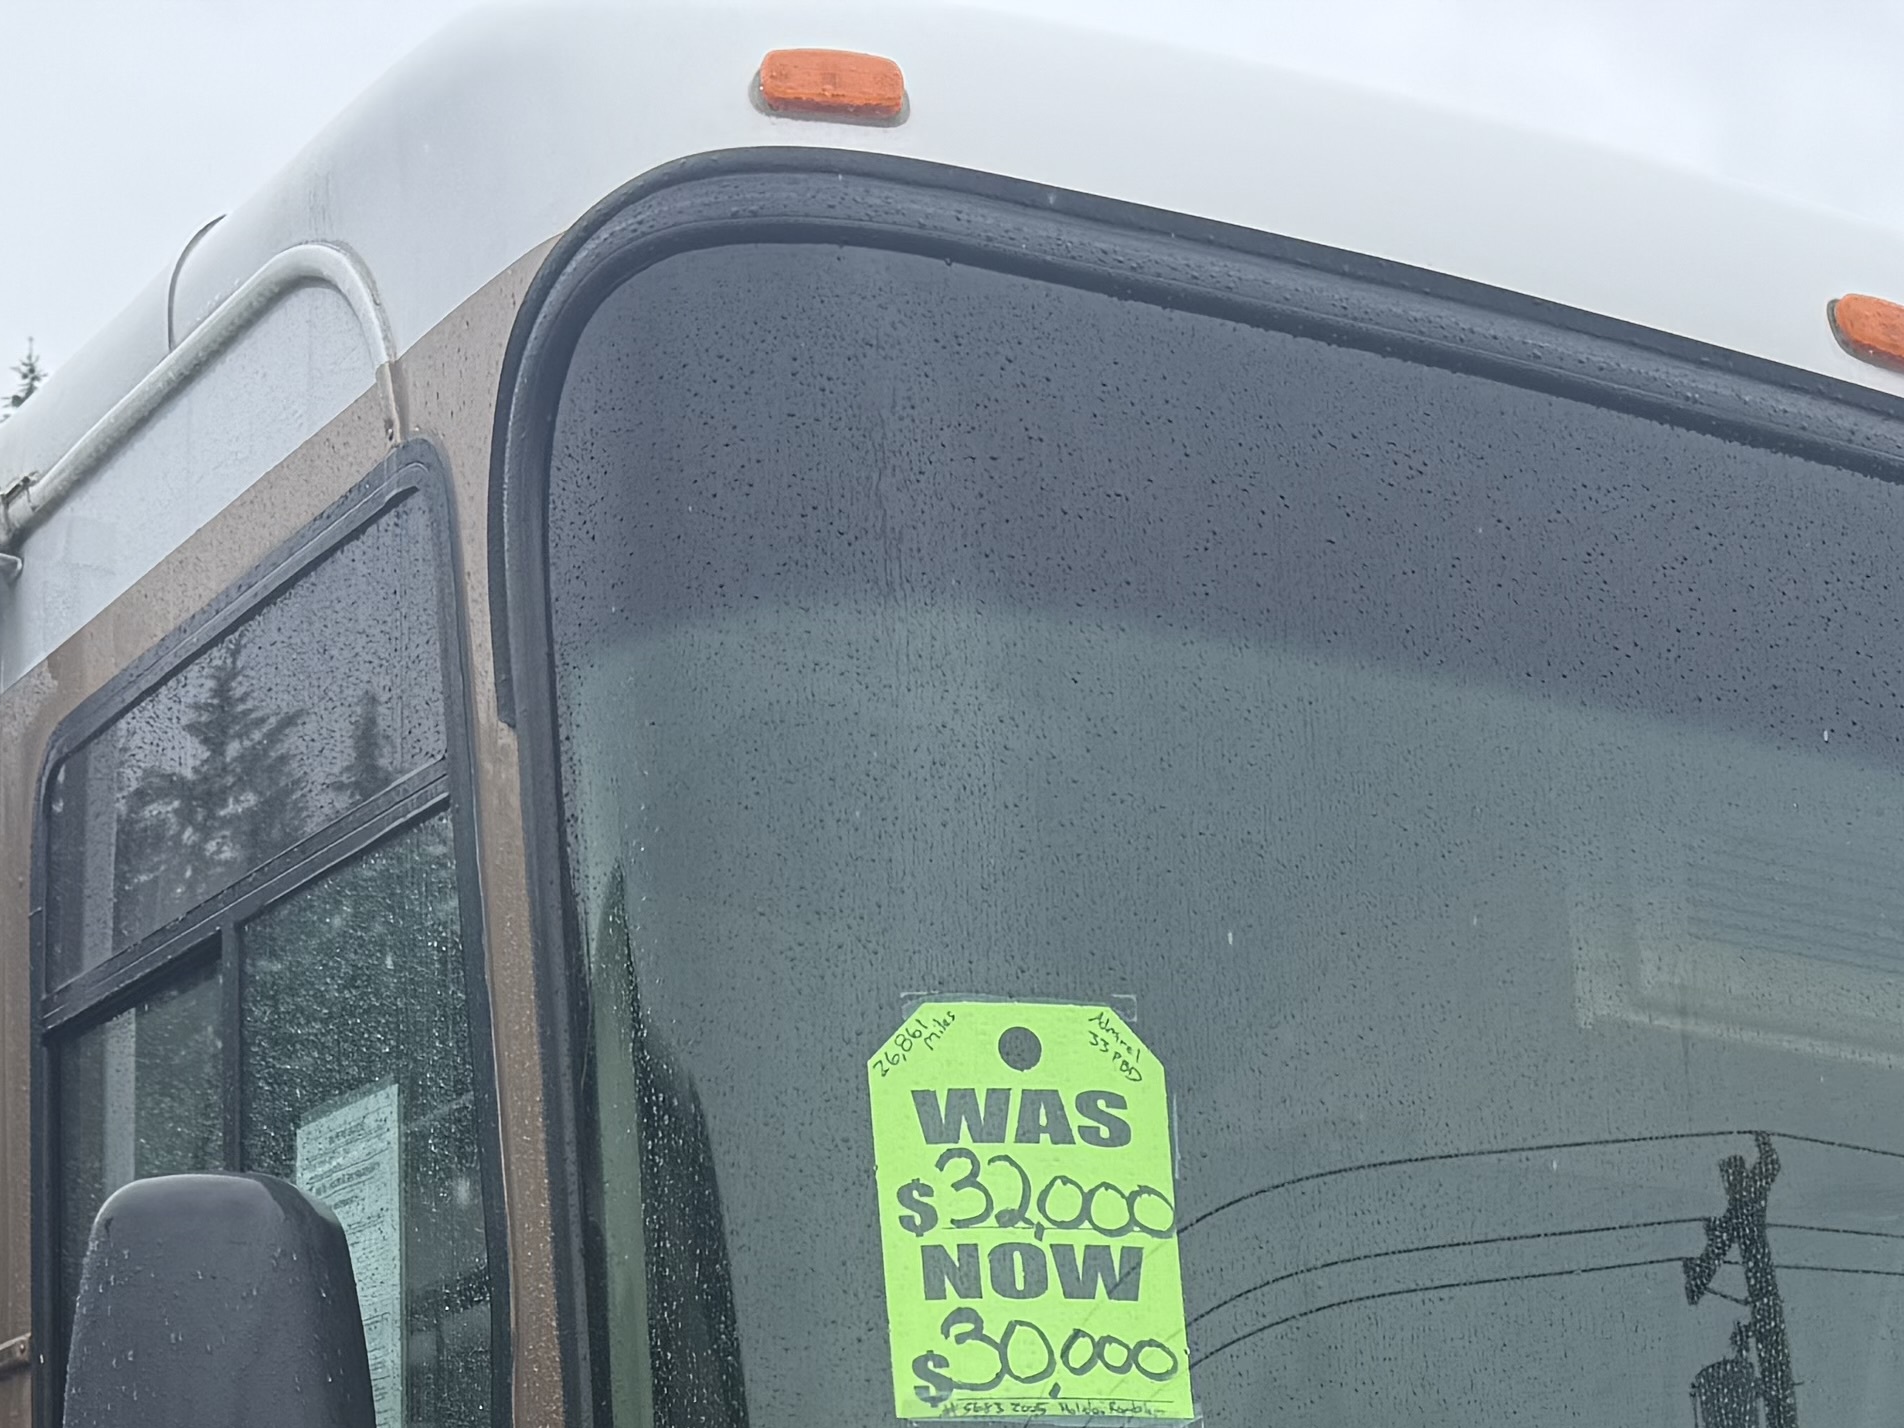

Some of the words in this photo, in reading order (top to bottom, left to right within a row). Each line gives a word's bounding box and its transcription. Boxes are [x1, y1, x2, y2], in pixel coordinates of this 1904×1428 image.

[872, 1018, 928, 1077] 26,861
[911, 1088, 1132, 1147] WAS
[897, 1147, 1176, 1242] $32,000
[921, 1242, 1143, 1301] NOW
[912, 1307, 1179, 1407] $30,000
